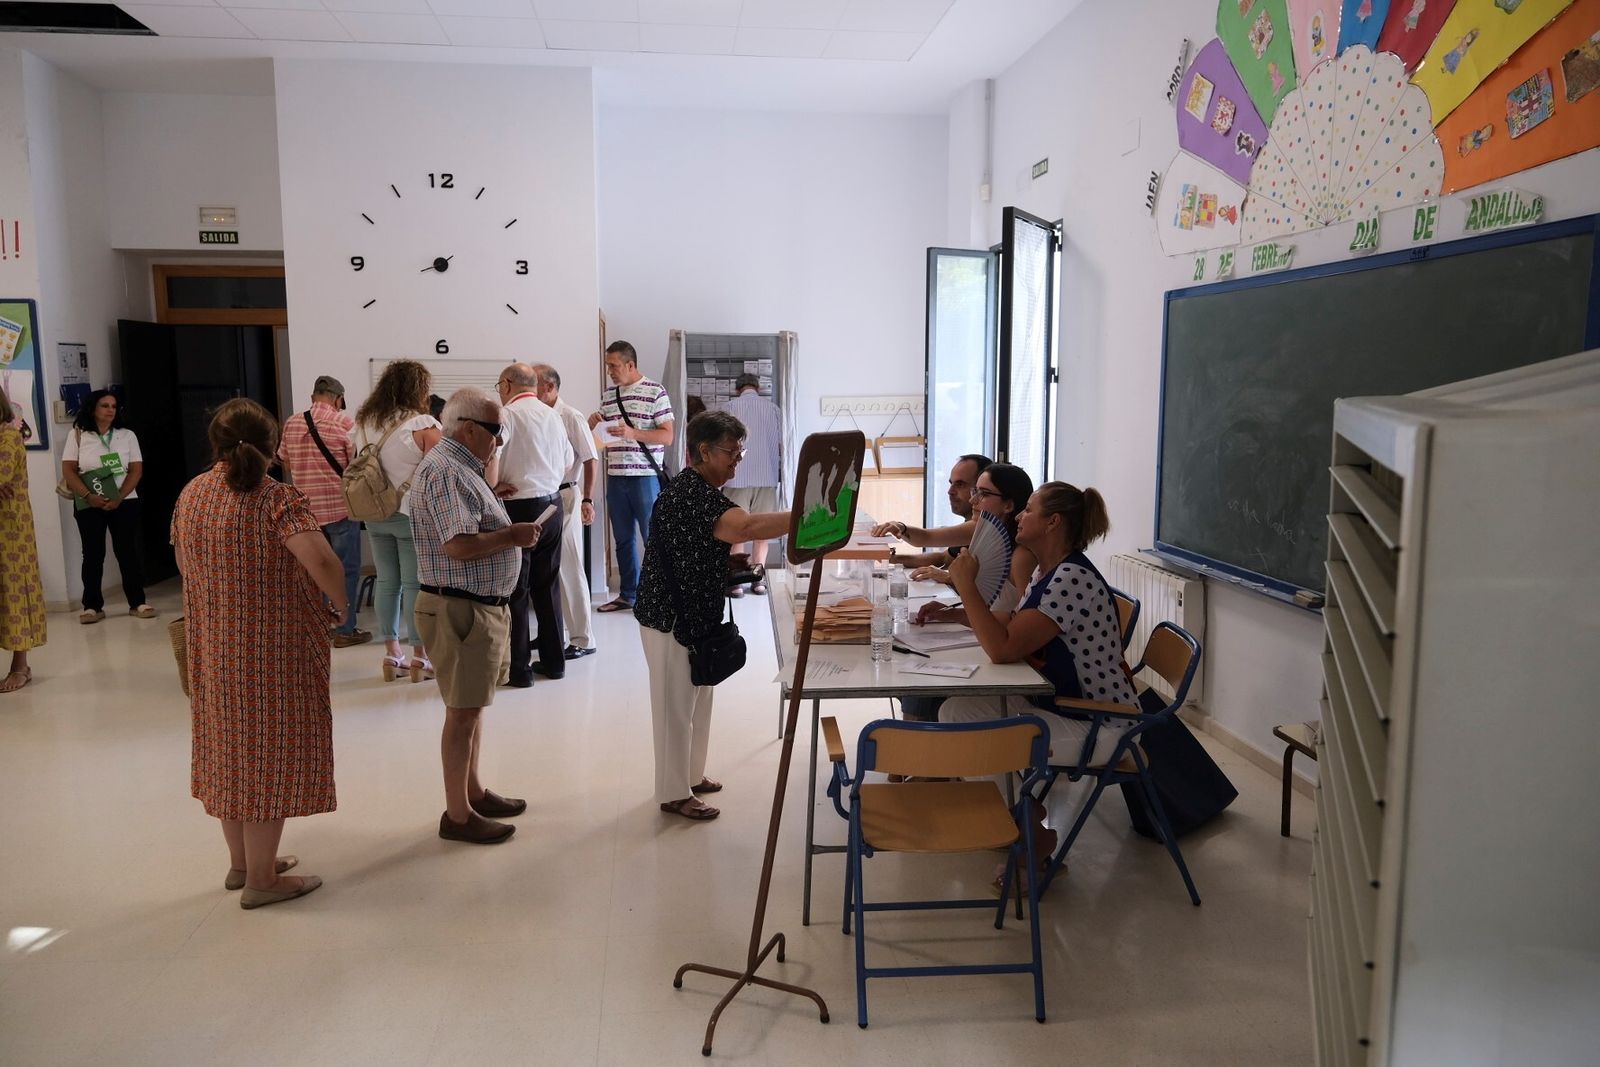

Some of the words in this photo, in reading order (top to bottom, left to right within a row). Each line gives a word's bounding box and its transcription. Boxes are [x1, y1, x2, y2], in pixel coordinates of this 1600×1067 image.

[428, 173, 454, 188] 12
[202, 232, 236, 242] SALIDA
[1194, 257, 1205, 281] 28
[1413, 205, 1437, 241] DE
[350, 256, 365, 271] 9
[515, 260, 529, 275] 3
[435, 339, 450, 354] 6
[92, 477, 105, 496] VOX
